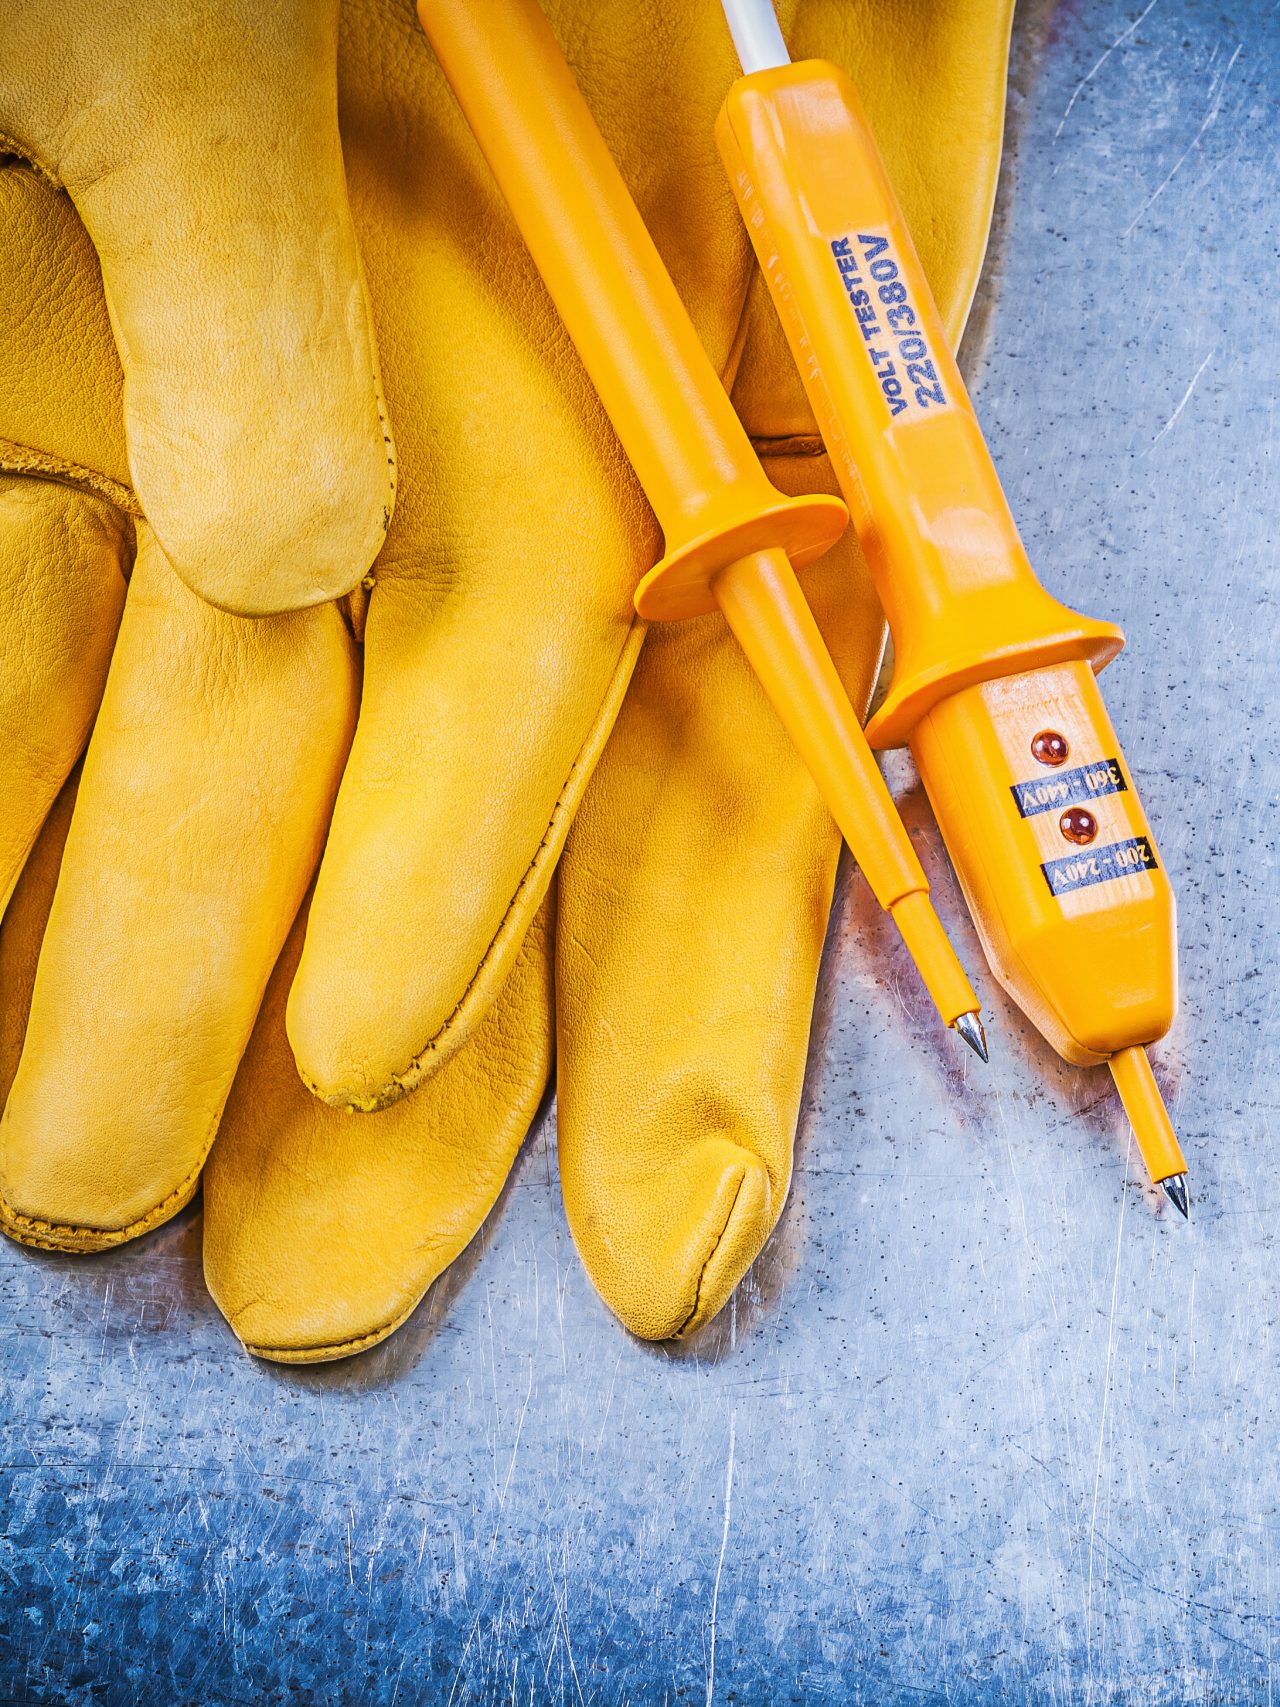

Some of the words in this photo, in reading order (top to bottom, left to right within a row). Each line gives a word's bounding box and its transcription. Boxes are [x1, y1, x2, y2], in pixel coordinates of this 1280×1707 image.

[830, 236, 882, 341] TESTER
[857, 234, 947, 408] 220/380V
[869, 348, 908, 416] VOLT
[1086, 766, 1120, 790] 360
[1022, 782, 1070, 809] 440V
[1115, 844, 1150, 868] 200
[1052, 858, 1101, 887] 240V
